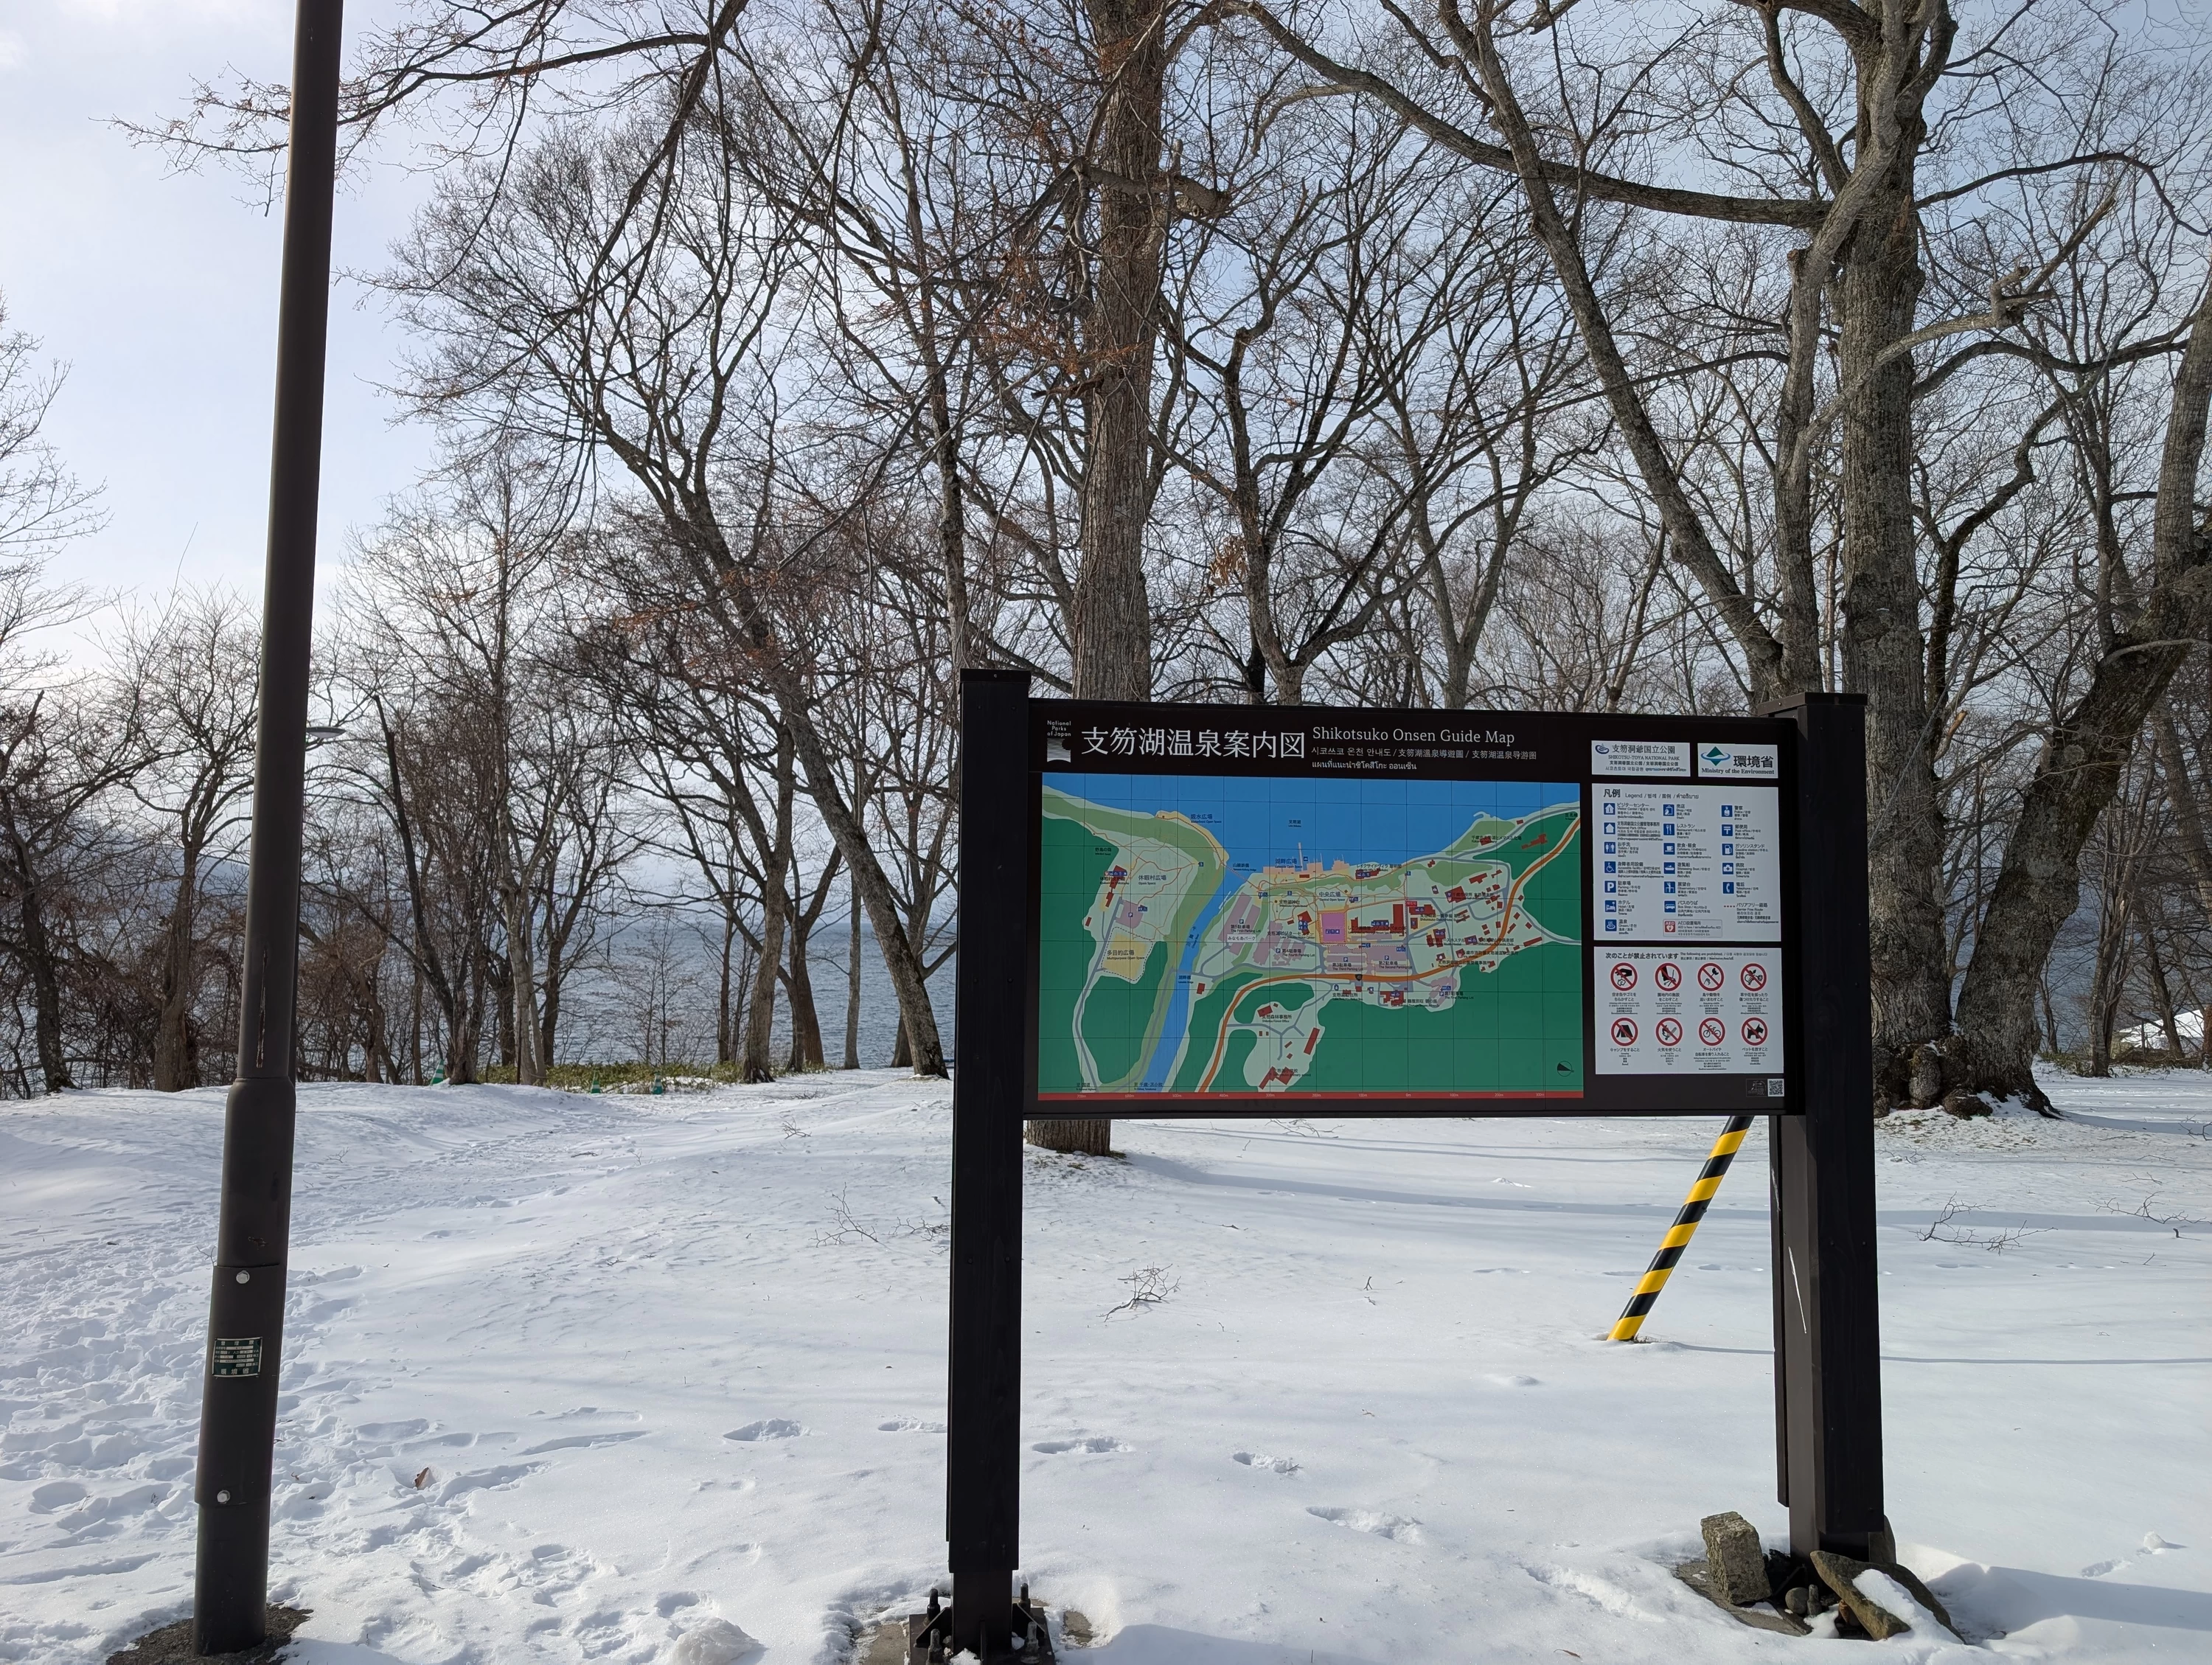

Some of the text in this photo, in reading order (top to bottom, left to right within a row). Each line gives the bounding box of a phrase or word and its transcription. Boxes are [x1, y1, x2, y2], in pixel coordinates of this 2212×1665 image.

[1312, 726, 1515, 747] Shikotsuko Onsen Guide Map
[1081, 726, 1305, 759] 支笏湖温泉案内図
[1347, 747, 1363, 757] 온천
[1366, 748, 1391, 757] 안내도
[1612, 744, 1675, 754] 支笏洞爺国立公園
[1733, 755, 1774, 768] 環境省
[1603, 788, 1621, 798] 凡例
